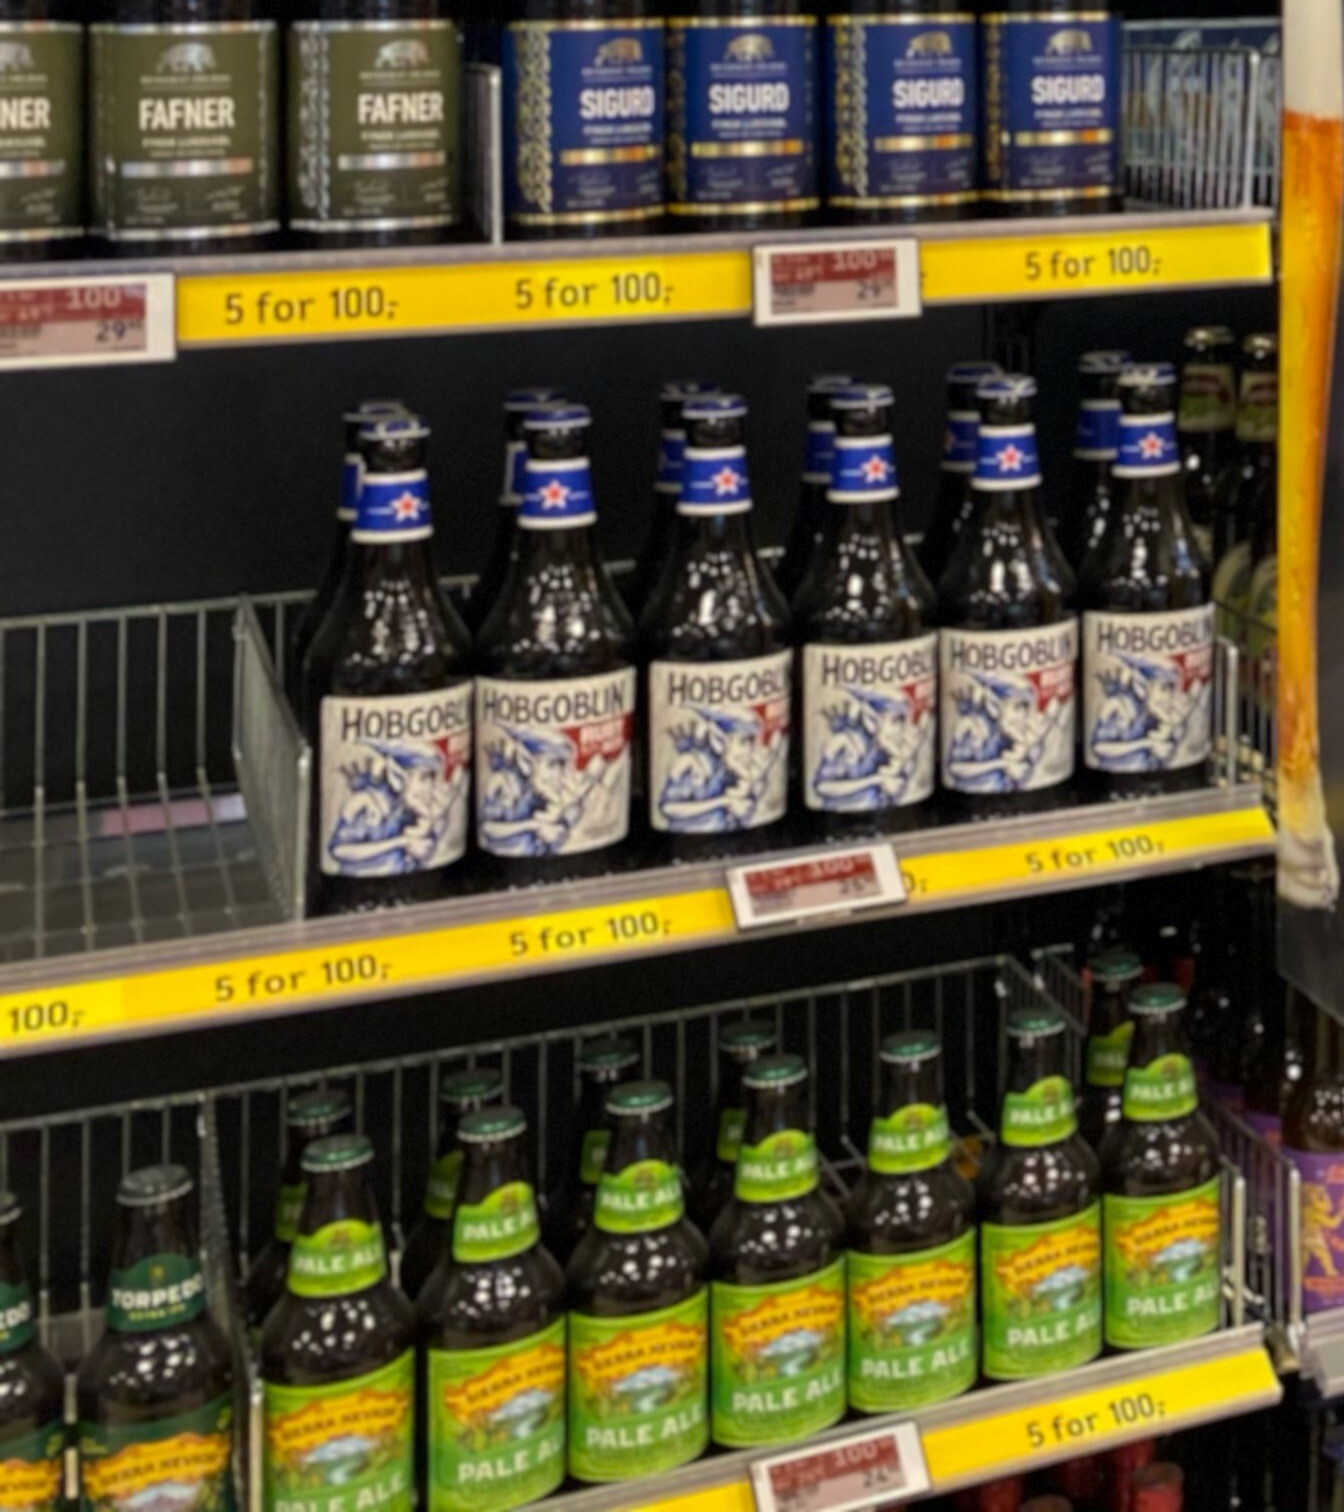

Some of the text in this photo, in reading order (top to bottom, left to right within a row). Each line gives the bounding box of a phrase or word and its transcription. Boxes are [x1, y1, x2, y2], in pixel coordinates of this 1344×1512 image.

[579, 85, 655, 119] SIGURD
[708, 82, 790, 114] SIGURD
[893, 78, 964, 108] SIGURD
[1031, 74, 1105, 104] SIGURD
[0, 98, 51, 129] NER
[138, 97, 235, 130] FAFNER
[357, 93, 445, 124] FAFNER
[1025, 251, 1041, 281] 5
[1050, 250, 1095, 278] for
[225, 293, 244, 324] 5
[257, 291, 314, 323] for
[516, 278, 533, 310] 5
[546, 277, 598, 307] for
[822, 650, 932, 685] HOBGOBL
[667, 664, 789, 705] HOBGOBL
[342, 694, 470, 741] HOBGOBL
[483, 684, 626, 723] HOBGOBLIN
[1025, 853, 1043, 874] 5
[1053, 845, 1098, 870] for
[509, 930, 528, 956] 5
[540, 924, 593, 951] for
[215, 976, 234, 1003] 5
[248, 970, 305, 998] for
[1126, 1291, 1190, 1317] PALE
[1007, 1322, 1070, 1347] PALE
[861, 1355, 925, 1380] PALE
[732, 1388, 799, 1414] PALE
[585, 1423, 653, 1449] PALE
[1026, 1421, 1045, 1449] 5
[1051, 1413, 1098, 1441] for
[458, 1448, 531, 1484] PALE
[275, 1494, 345, 1512] PALE
